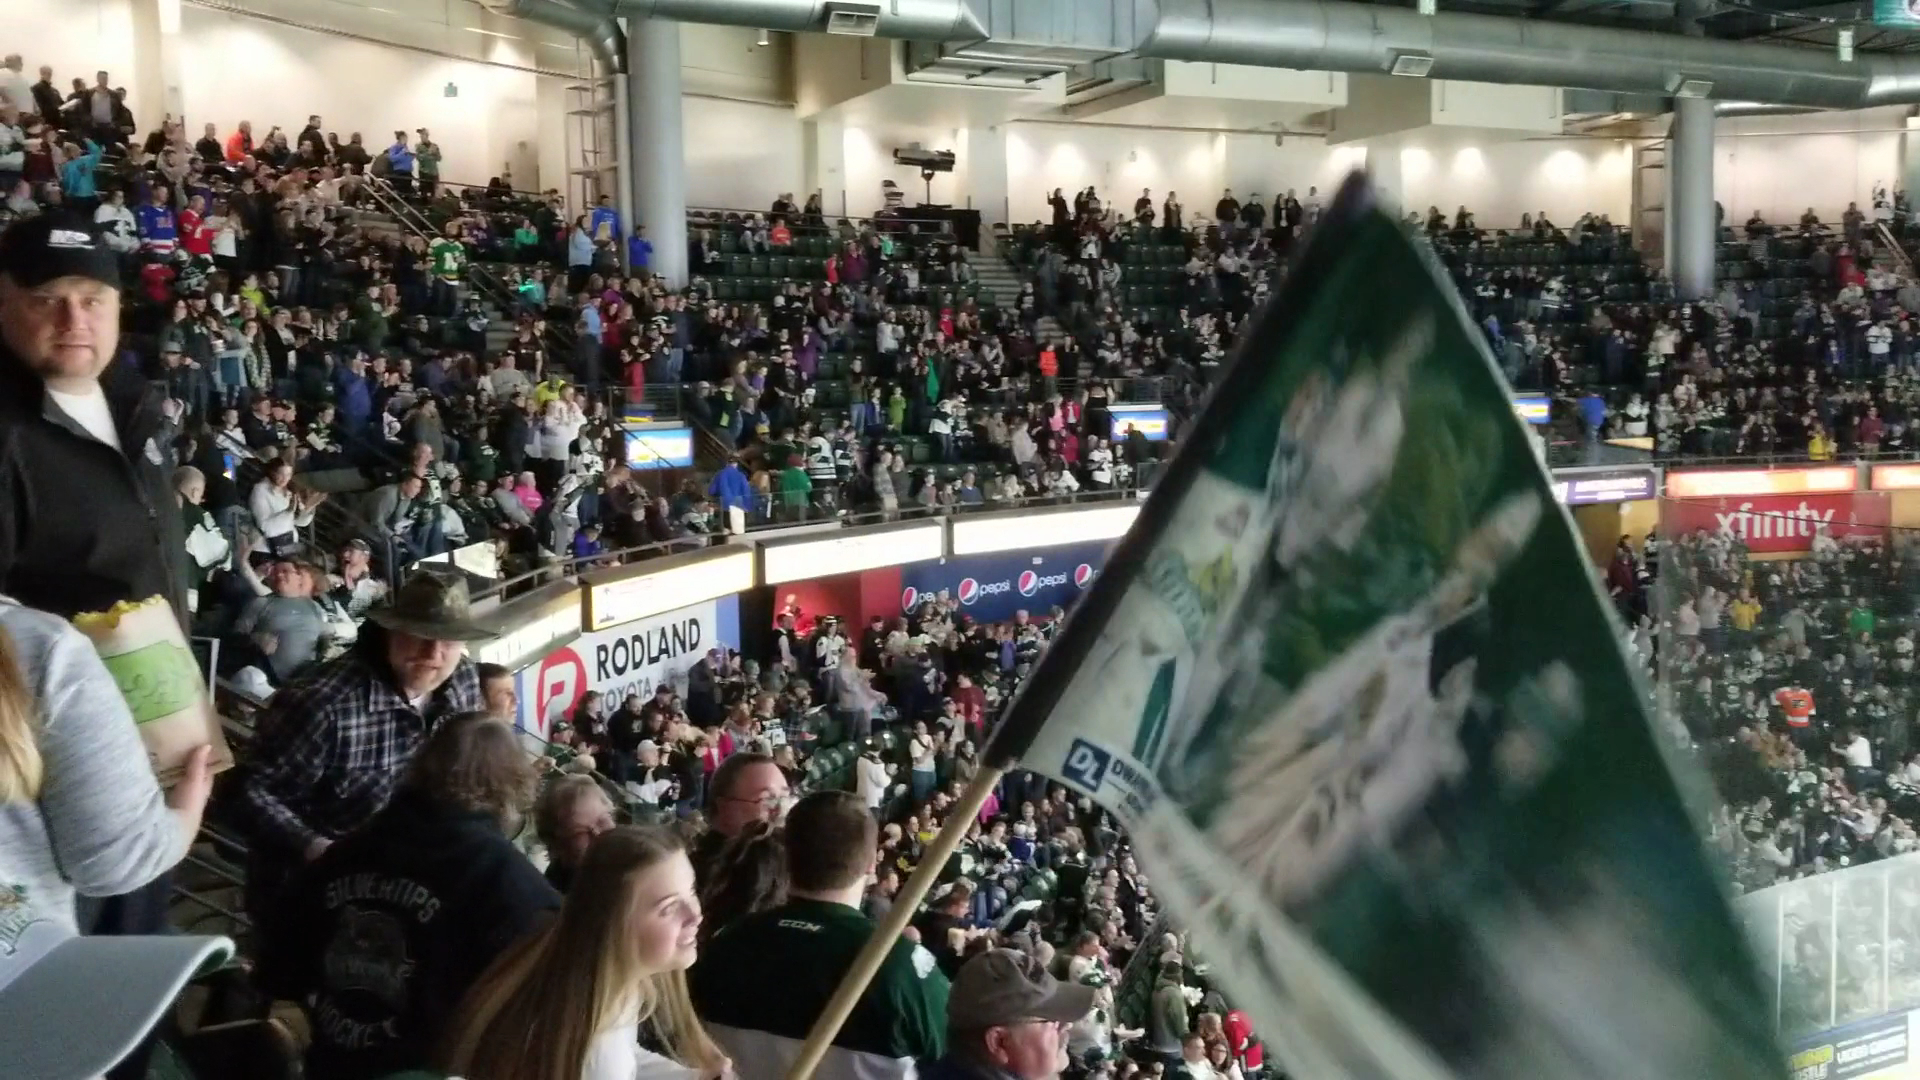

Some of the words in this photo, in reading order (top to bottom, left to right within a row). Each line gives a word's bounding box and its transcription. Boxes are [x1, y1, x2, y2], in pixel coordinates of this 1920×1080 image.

[1714, 501, 1835, 542] xfinity
[979, 580, 1010, 597] pepsi
[1038, 572, 1067, 588] pepsi
[596, 617, 701, 682] RODLAND
